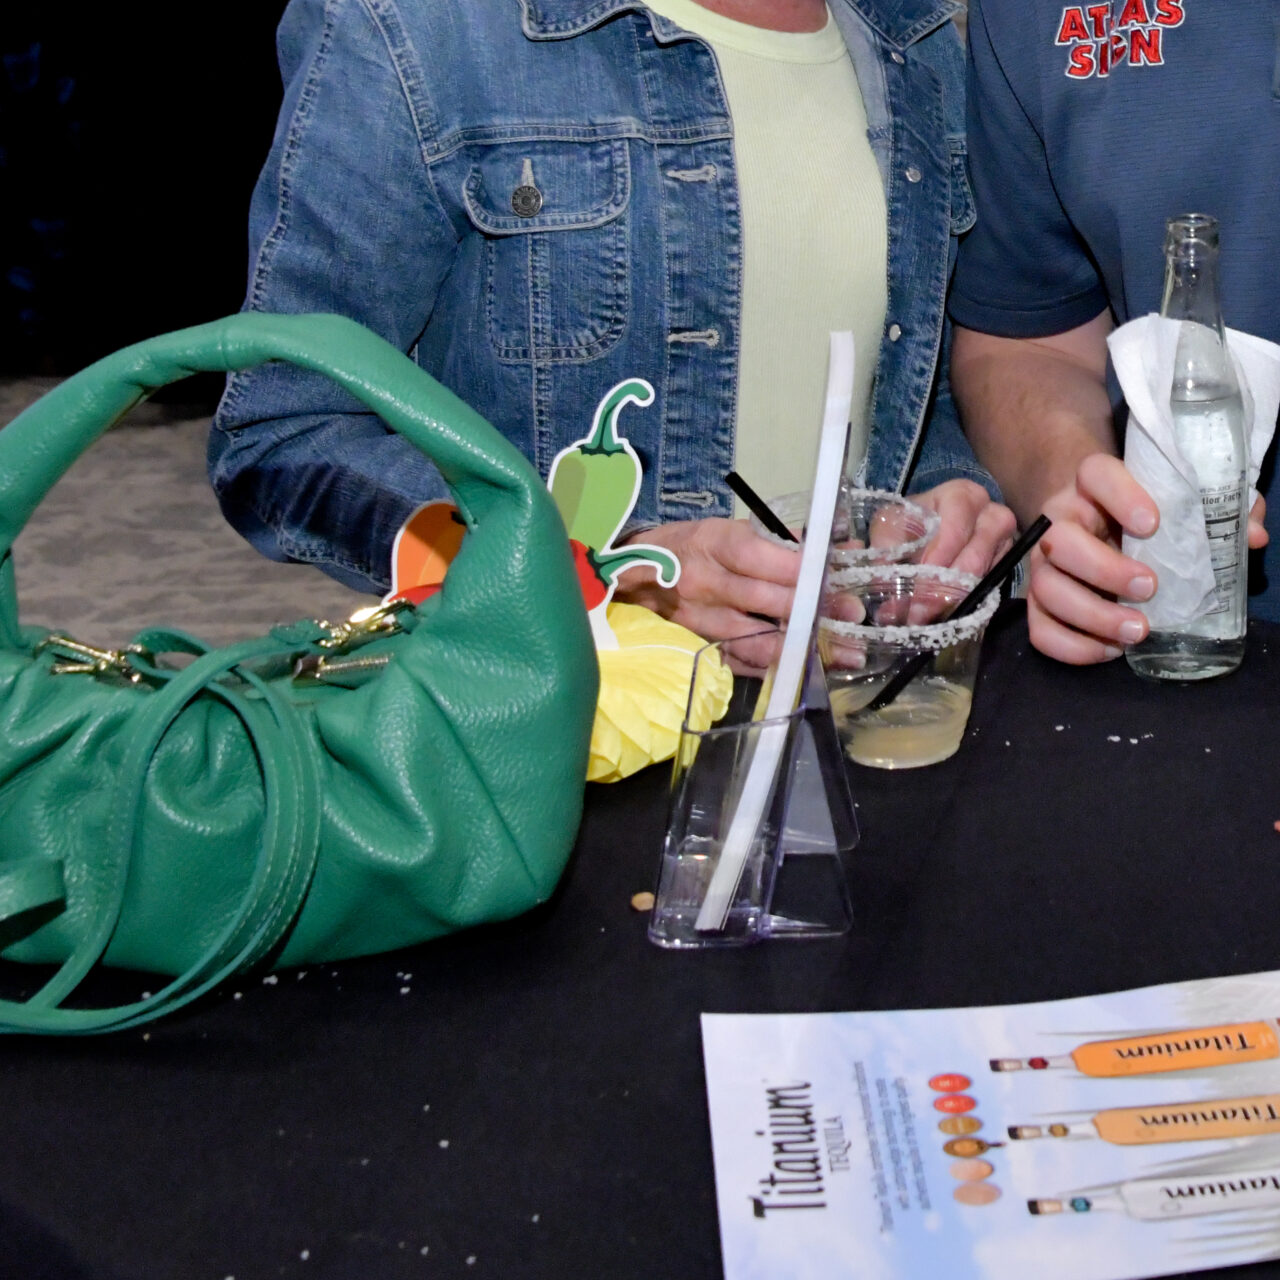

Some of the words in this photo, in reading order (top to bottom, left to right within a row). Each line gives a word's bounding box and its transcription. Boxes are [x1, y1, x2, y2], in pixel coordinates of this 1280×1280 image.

[1114, 1031, 1256, 1060] Titanium
[748, 1080, 828, 1218] Titanium
[823, 1115, 851, 1173] TEQUILA
